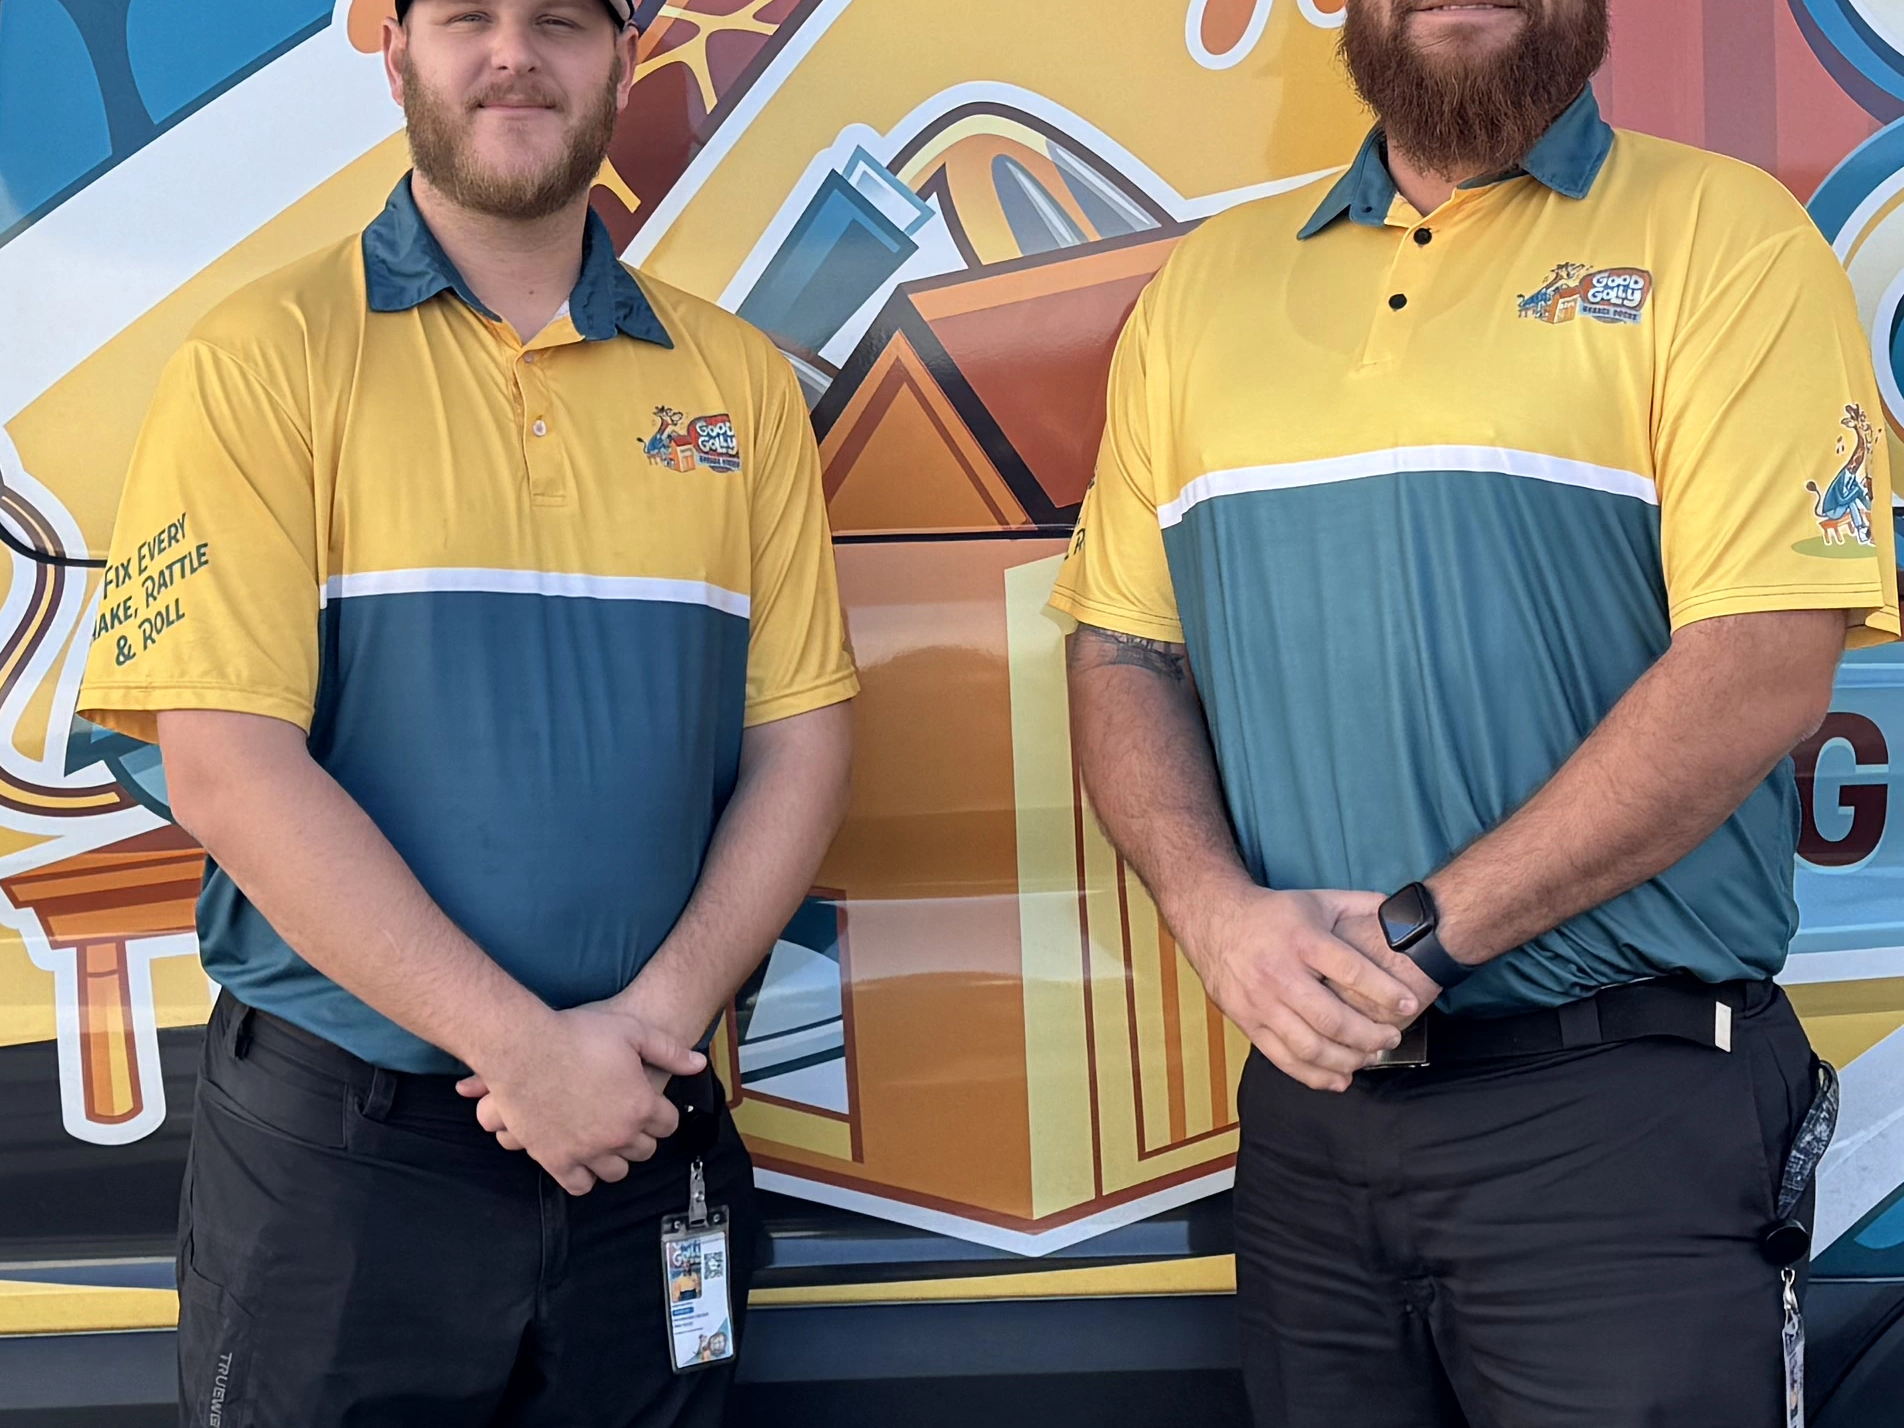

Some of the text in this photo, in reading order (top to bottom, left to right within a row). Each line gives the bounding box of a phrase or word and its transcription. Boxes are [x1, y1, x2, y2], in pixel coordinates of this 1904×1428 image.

[1587, 285, 1642, 307] GOLLY
[1592, 272, 1644, 290] GOOD
[698, 435, 737, 455] GOLLY
[103, 512, 187, 600] FIX EVERY
[141, 542, 209, 609] RATTLE
[115, 597, 185, 666] & ROLL
